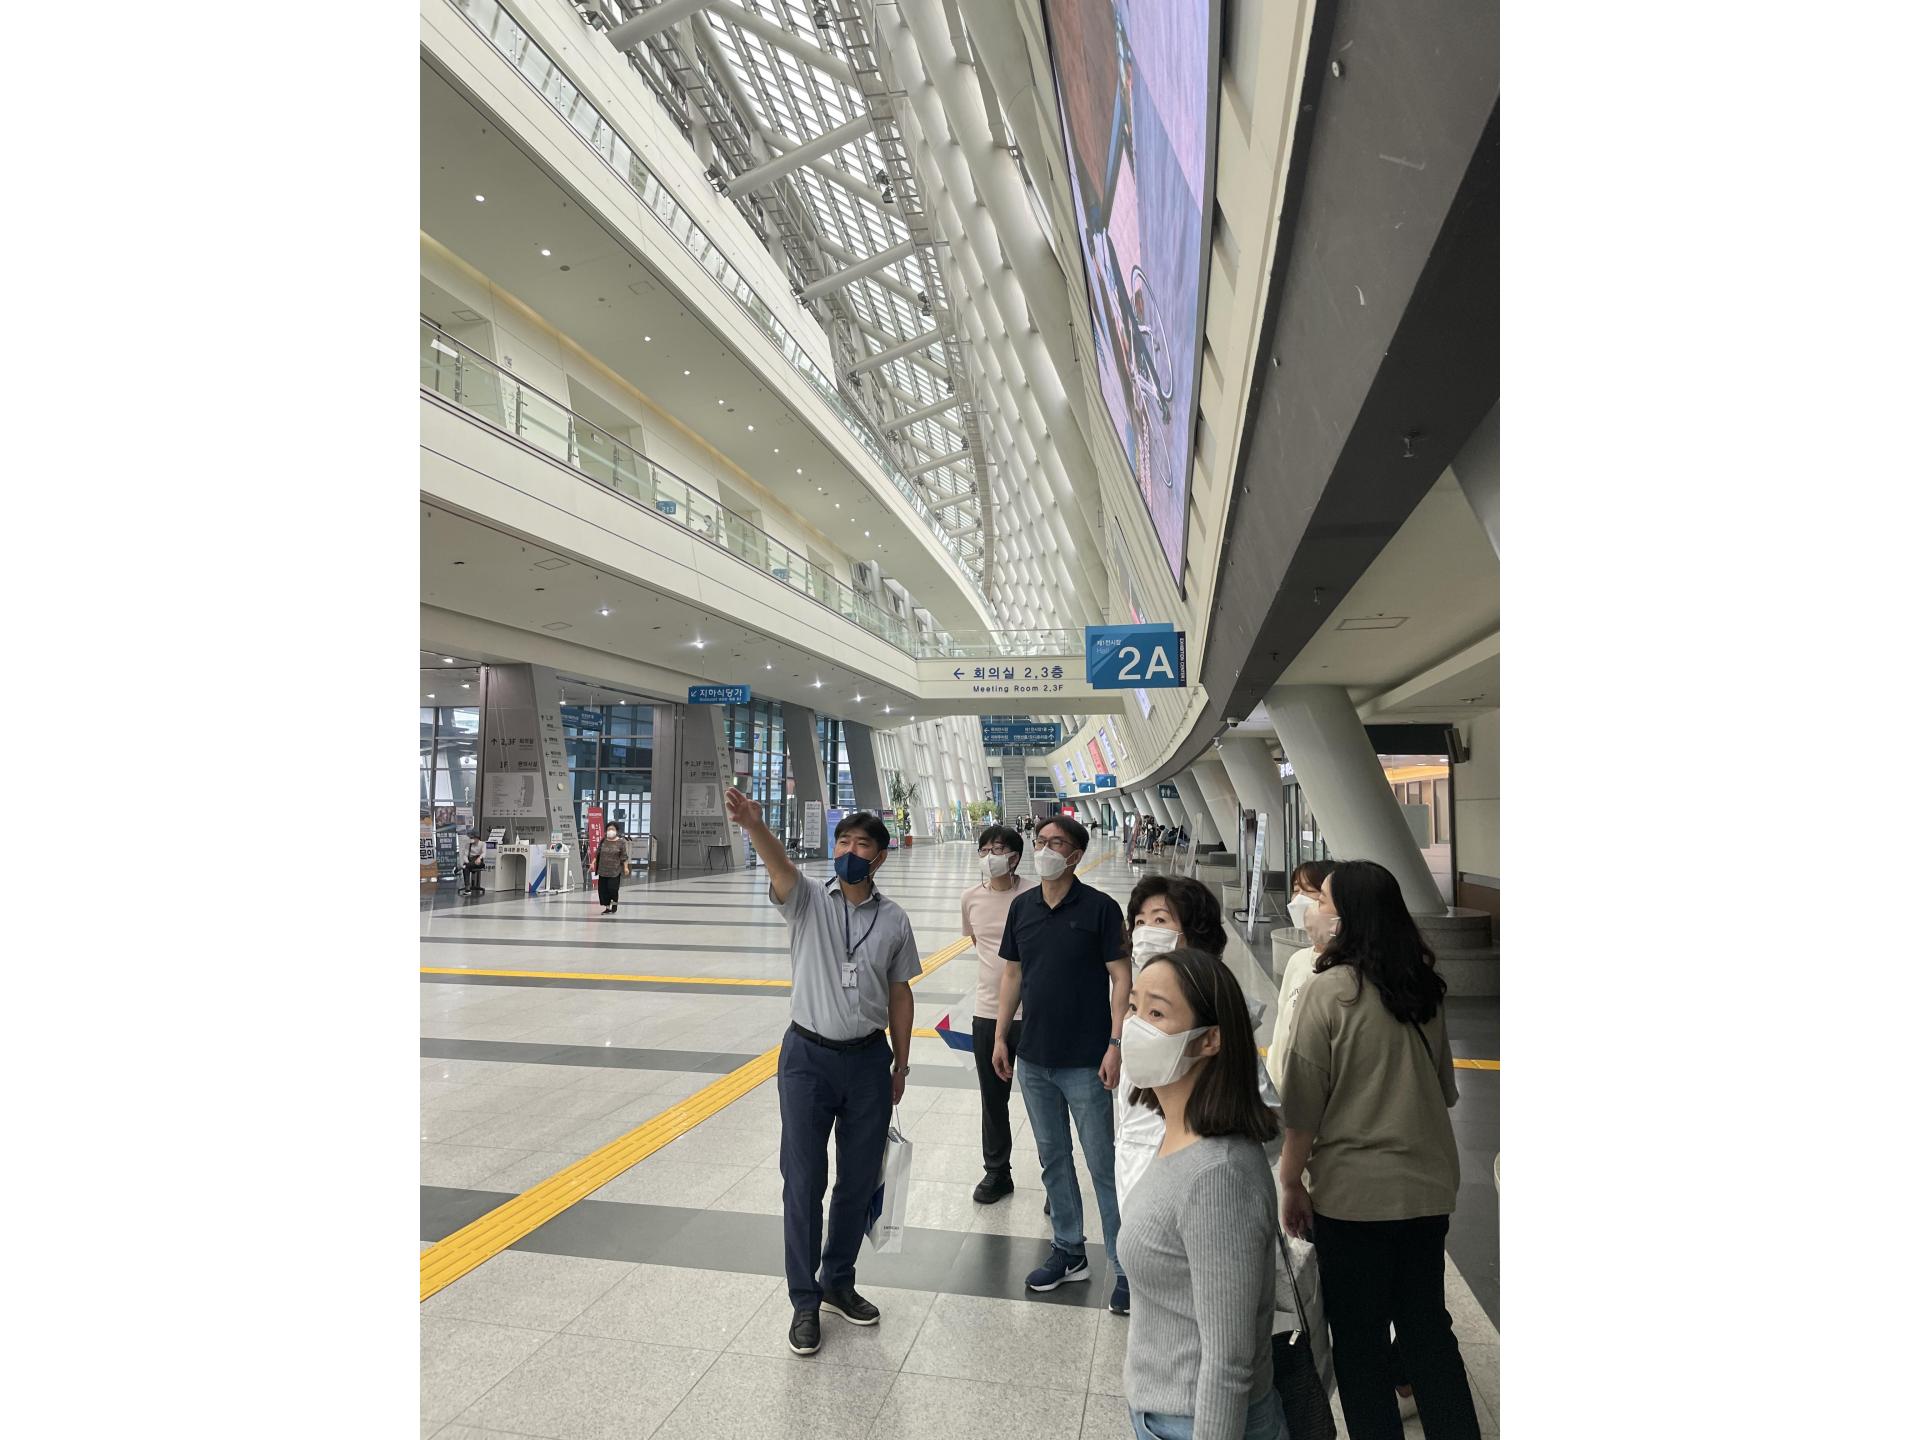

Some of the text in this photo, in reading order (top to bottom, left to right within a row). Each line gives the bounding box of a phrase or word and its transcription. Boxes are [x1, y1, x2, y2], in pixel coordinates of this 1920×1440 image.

[1118, 645, 1175, 680] 2A
[973, 666, 1014, 679] 회의실
[973, 685, 1009, 693] Meeting
